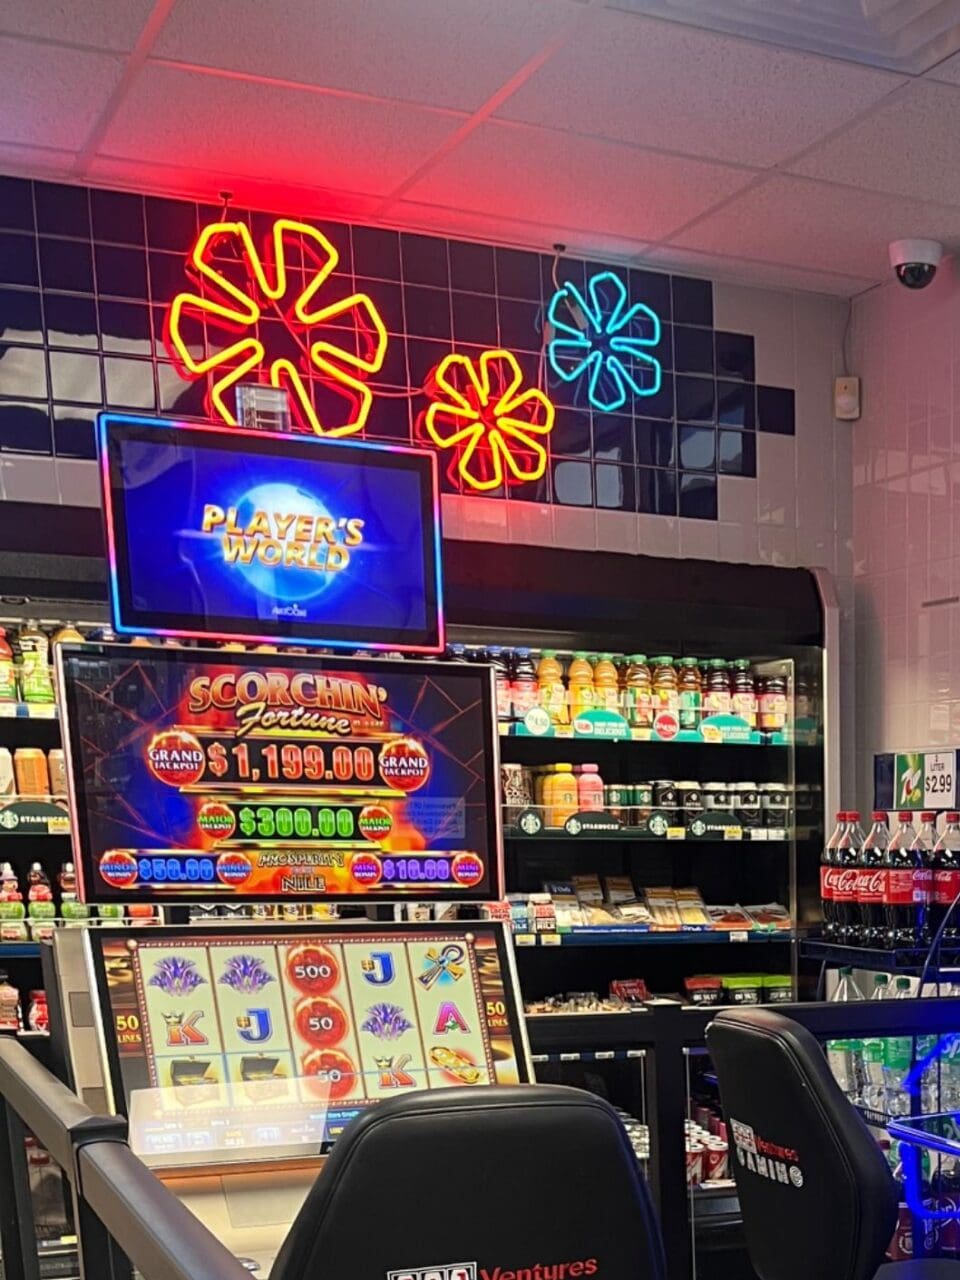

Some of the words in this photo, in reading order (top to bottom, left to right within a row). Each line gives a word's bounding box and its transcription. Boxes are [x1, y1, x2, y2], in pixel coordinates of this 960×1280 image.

[202, 504, 365, 546] PLAYER'S
[223, 534, 350, 572] WORLD
[189, 671, 388, 717] SCORCHIN'
[235, 701, 352, 737] Fortune
[149, 749, 203, 763] GRAND
[379, 756, 429, 769] GRAND
[154, 761, 199, 771] JACKPOT
[383, 767, 425, 777] JACKPOT
[239, 807, 354, 837] $300.00
[282, 875, 326, 892] NILE
[295, 965, 331, 979] 500
[486, 1002, 505, 1015] 50
[116, 1015, 139, 1031] 50
[309, 1017, 333, 1031] 50
